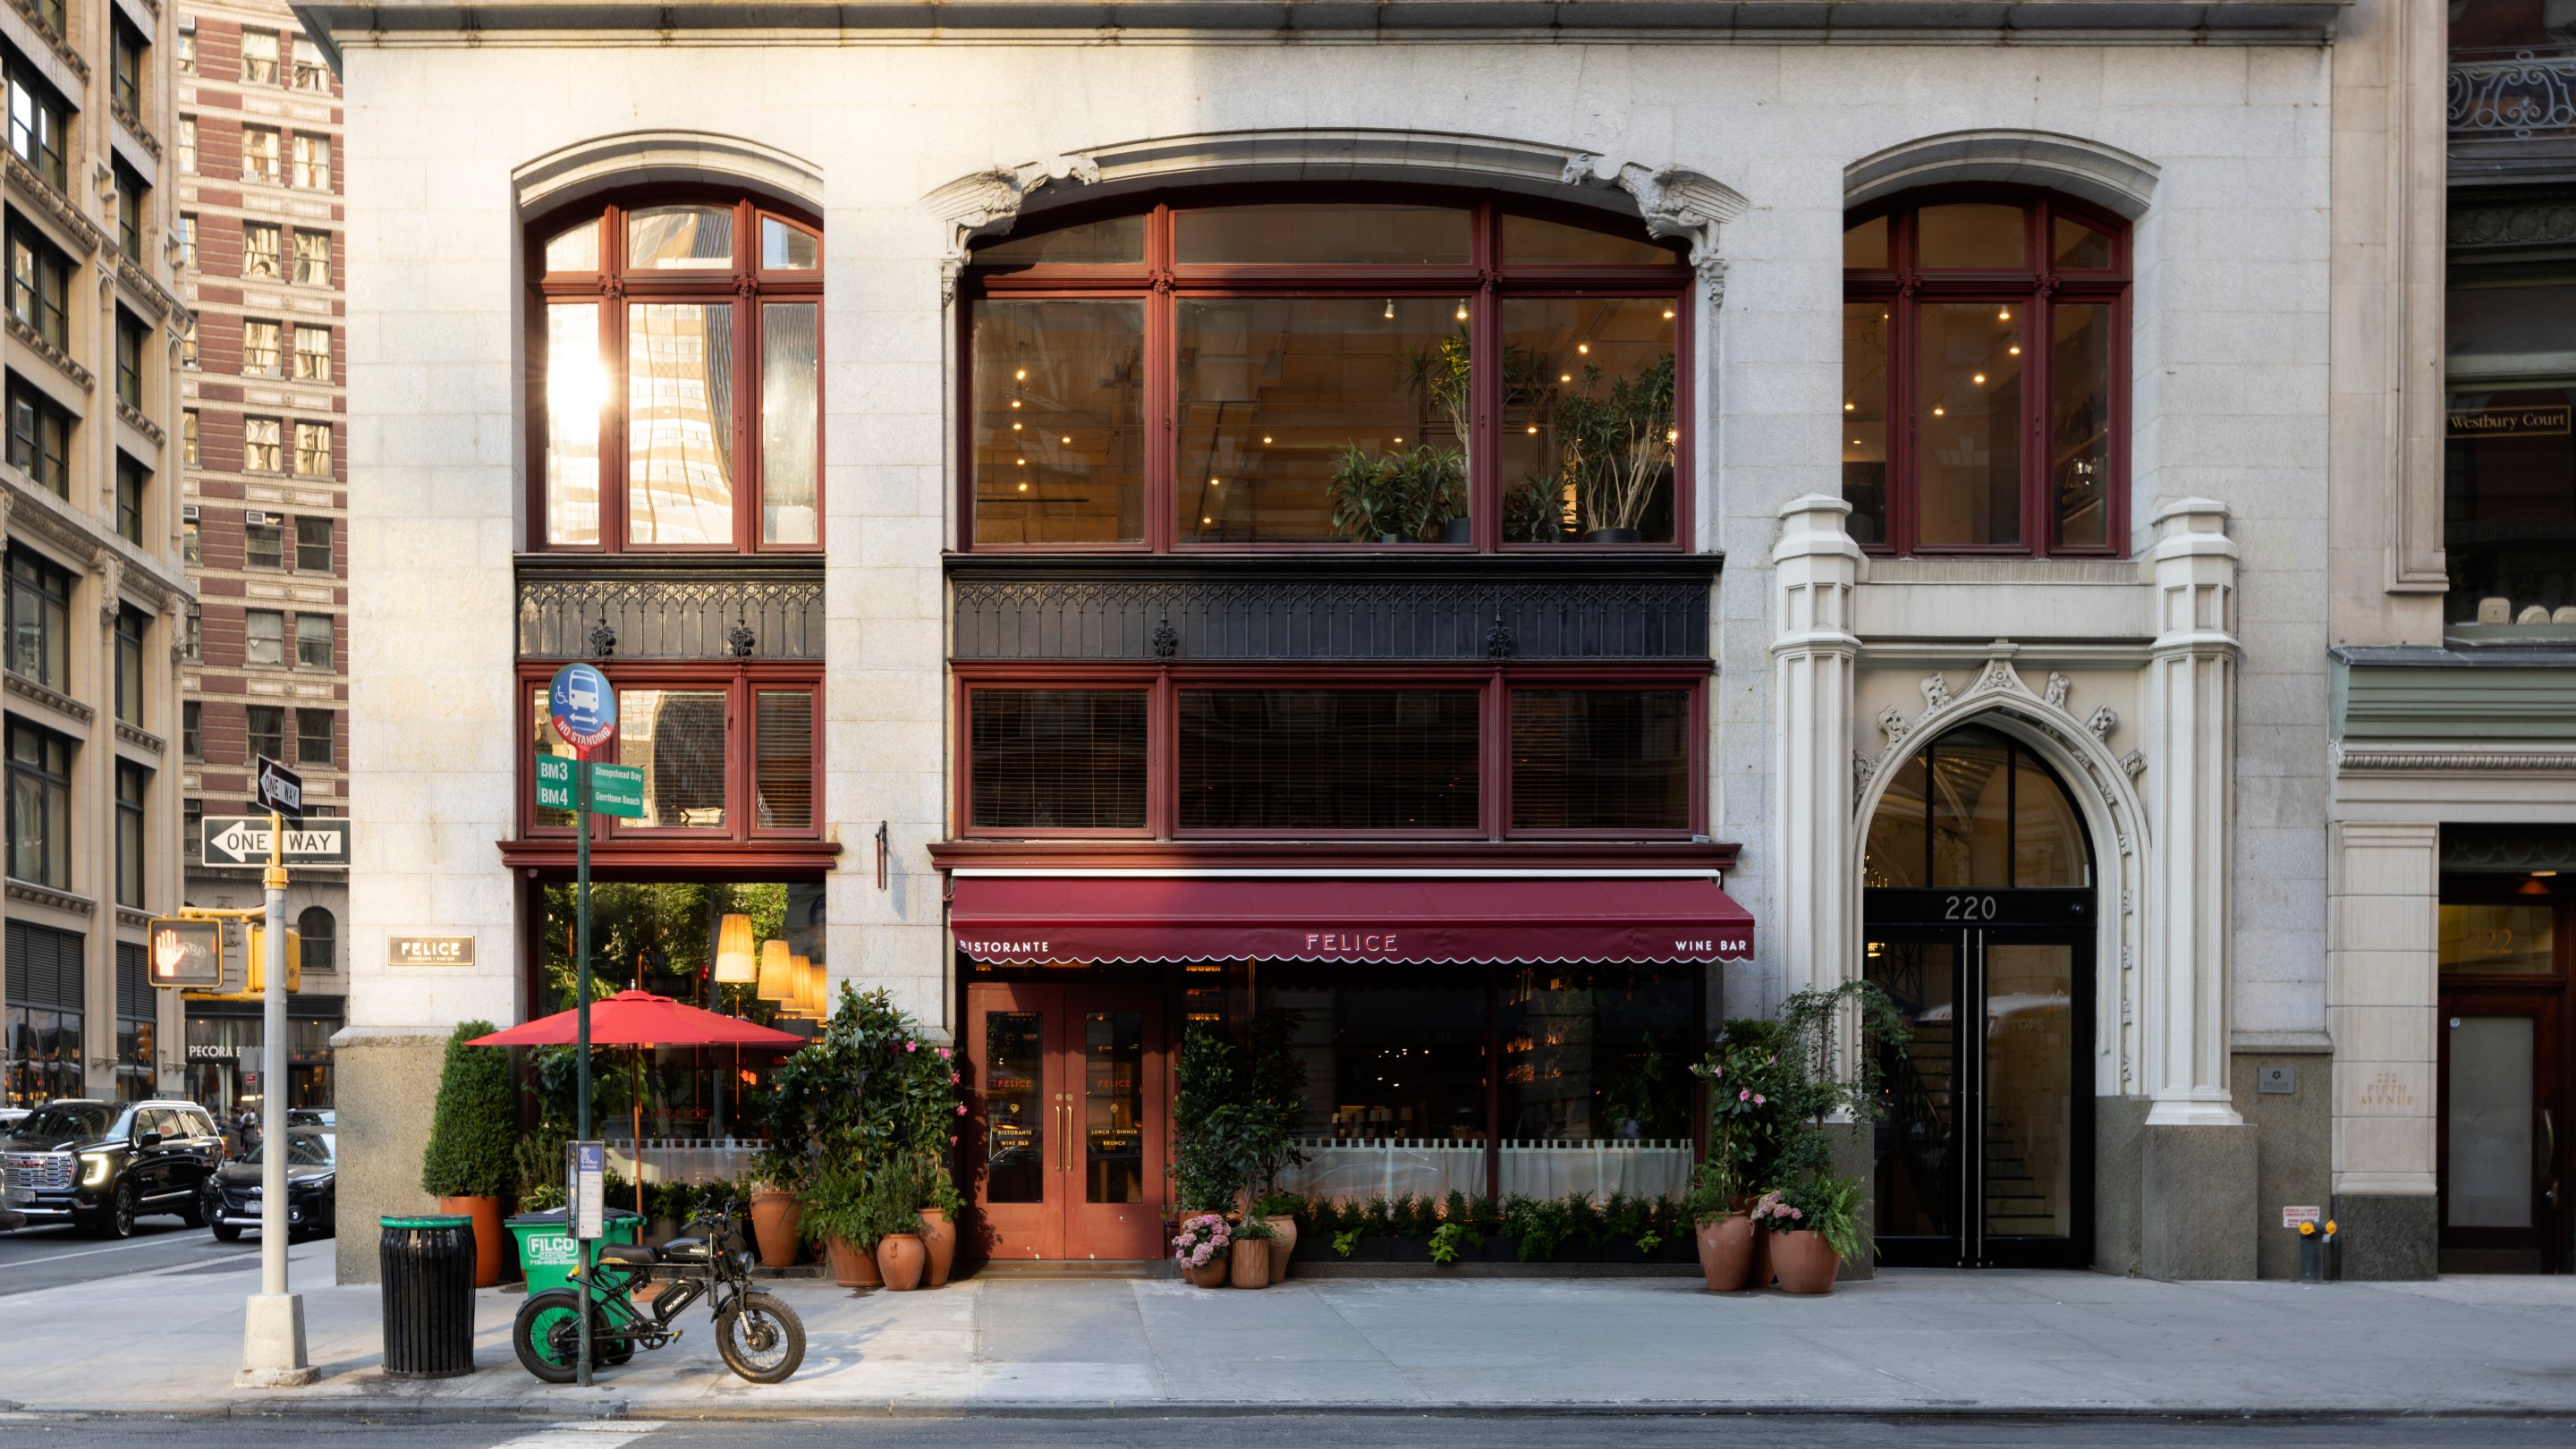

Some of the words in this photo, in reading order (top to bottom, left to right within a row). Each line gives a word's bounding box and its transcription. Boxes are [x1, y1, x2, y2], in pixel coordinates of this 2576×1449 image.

[2452, 413, 2518, 430] Westbury
[2522, 412, 2565, 427] Court
[557, 720, 571, 736] NO
[571, 726, 611, 746] STANDING
[540, 762, 568, 781] BM3
[595, 766, 630, 779] Sheepshead
[631, 769, 642, 783] Bay
[265, 775, 279, 797] ONE
[284, 783, 298, 806] WAY
[541, 787, 568, 806] BM4
[595, 791, 622, 804] Gerritsen
[623, 792, 640, 806] Beach
[226, 833, 267, 851] ONE
[288, 834, 332, 852] WAY
[1945, 895, 1996, 919] 220
[401, 942, 460, 956] FELICE
[960, 939, 1048, 953] RISTORANTE
[1306, 933, 1397, 952] FELICE
[1674, 940, 1712, 951] WINE
[1720, 940, 1746, 951] BAR
[189, 1045, 233, 1057] PECORA
[997, 1080, 1031, 1088] FELICE
[1097, 1080, 1131, 1088] FELICE
[2377, 1073, 2397, 1083] 222
[2367, 1084, 2407, 1094] FIFTH
[2360, 1096, 2414, 1106] AVENUE
[655, 1108, 708, 1120] FELICE
[530, 1237, 574, 1252] FILCO
